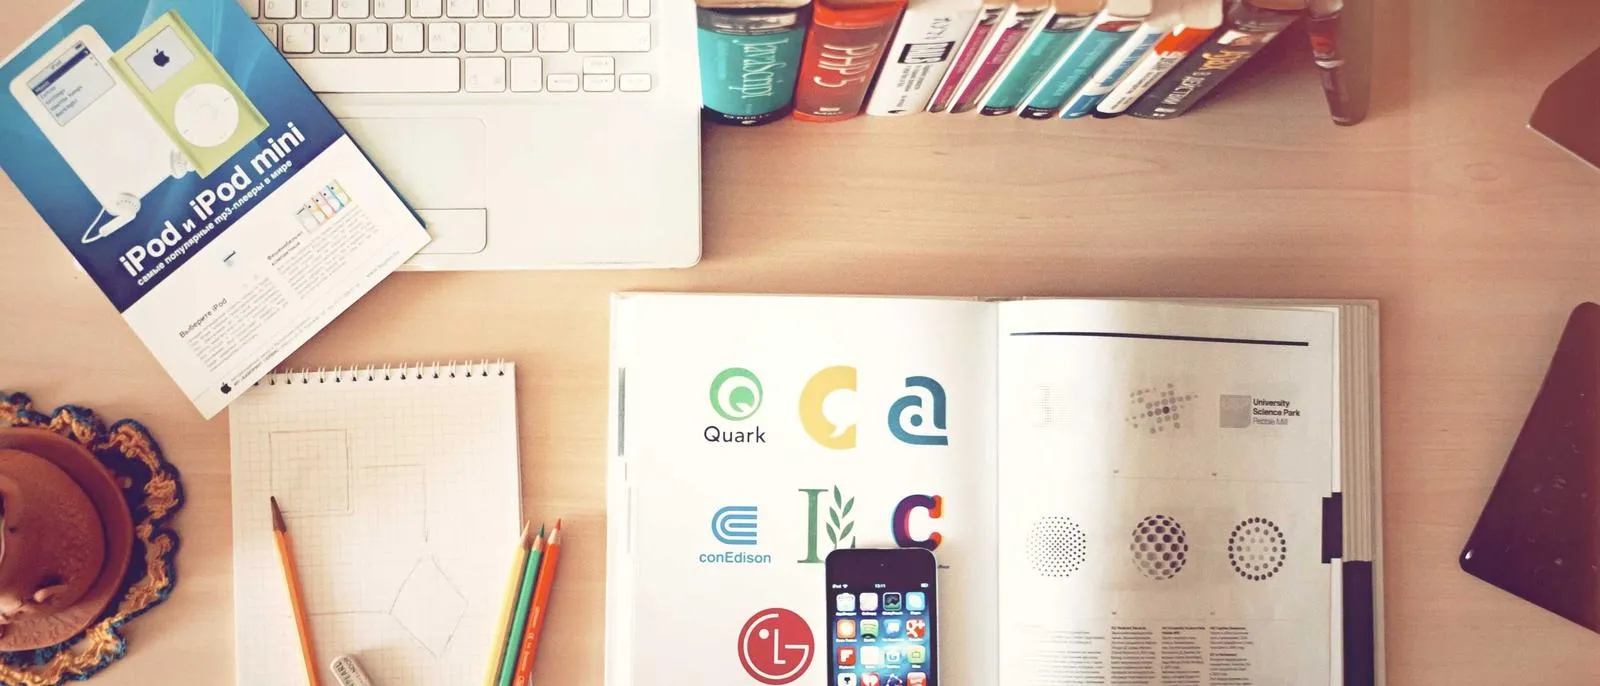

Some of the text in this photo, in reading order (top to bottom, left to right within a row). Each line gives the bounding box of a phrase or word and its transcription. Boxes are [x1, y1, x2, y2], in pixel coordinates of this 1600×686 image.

[729, 38, 789, 98] JavaScript
[818, 43, 879, 76] PHP
[814, 75, 866, 87] 5
[119, 121, 305, 276] iPod и iPod mini
[137, 262, 165, 285] самые
[164, 222, 214, 264] популярные
[214, 182, 264, 224] mp3-плееры
[270, 160, 292, 179] мире
[178, 297, 227, 338] Выберите iPod
[1253, 398, 1290, 408] University
[1253, 408, 1282, 416] Science
[704, 425, 766, 444] Quark
[699, 552, 771, 564] conEdison
